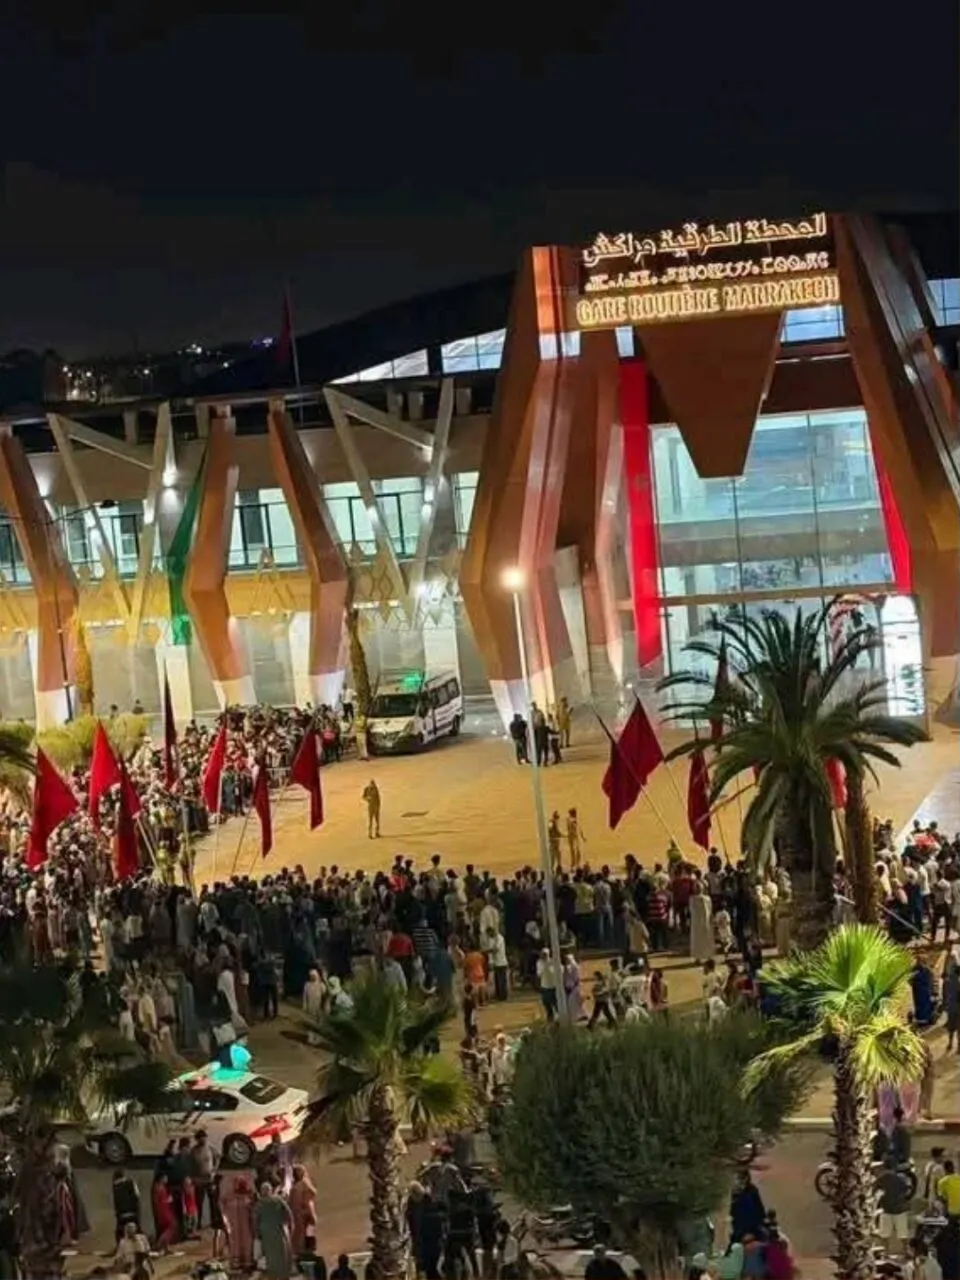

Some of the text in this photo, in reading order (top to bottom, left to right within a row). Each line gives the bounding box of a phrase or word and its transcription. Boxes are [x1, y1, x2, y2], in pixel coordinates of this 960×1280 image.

[583, 212, 827, 268] المحطة الطرقية مراكش
[577, 296, 627, 325] GARE
[628, 284, 721, 320] ROUTIÈRE
[722, 276, 840, 312] MARRAKECH
